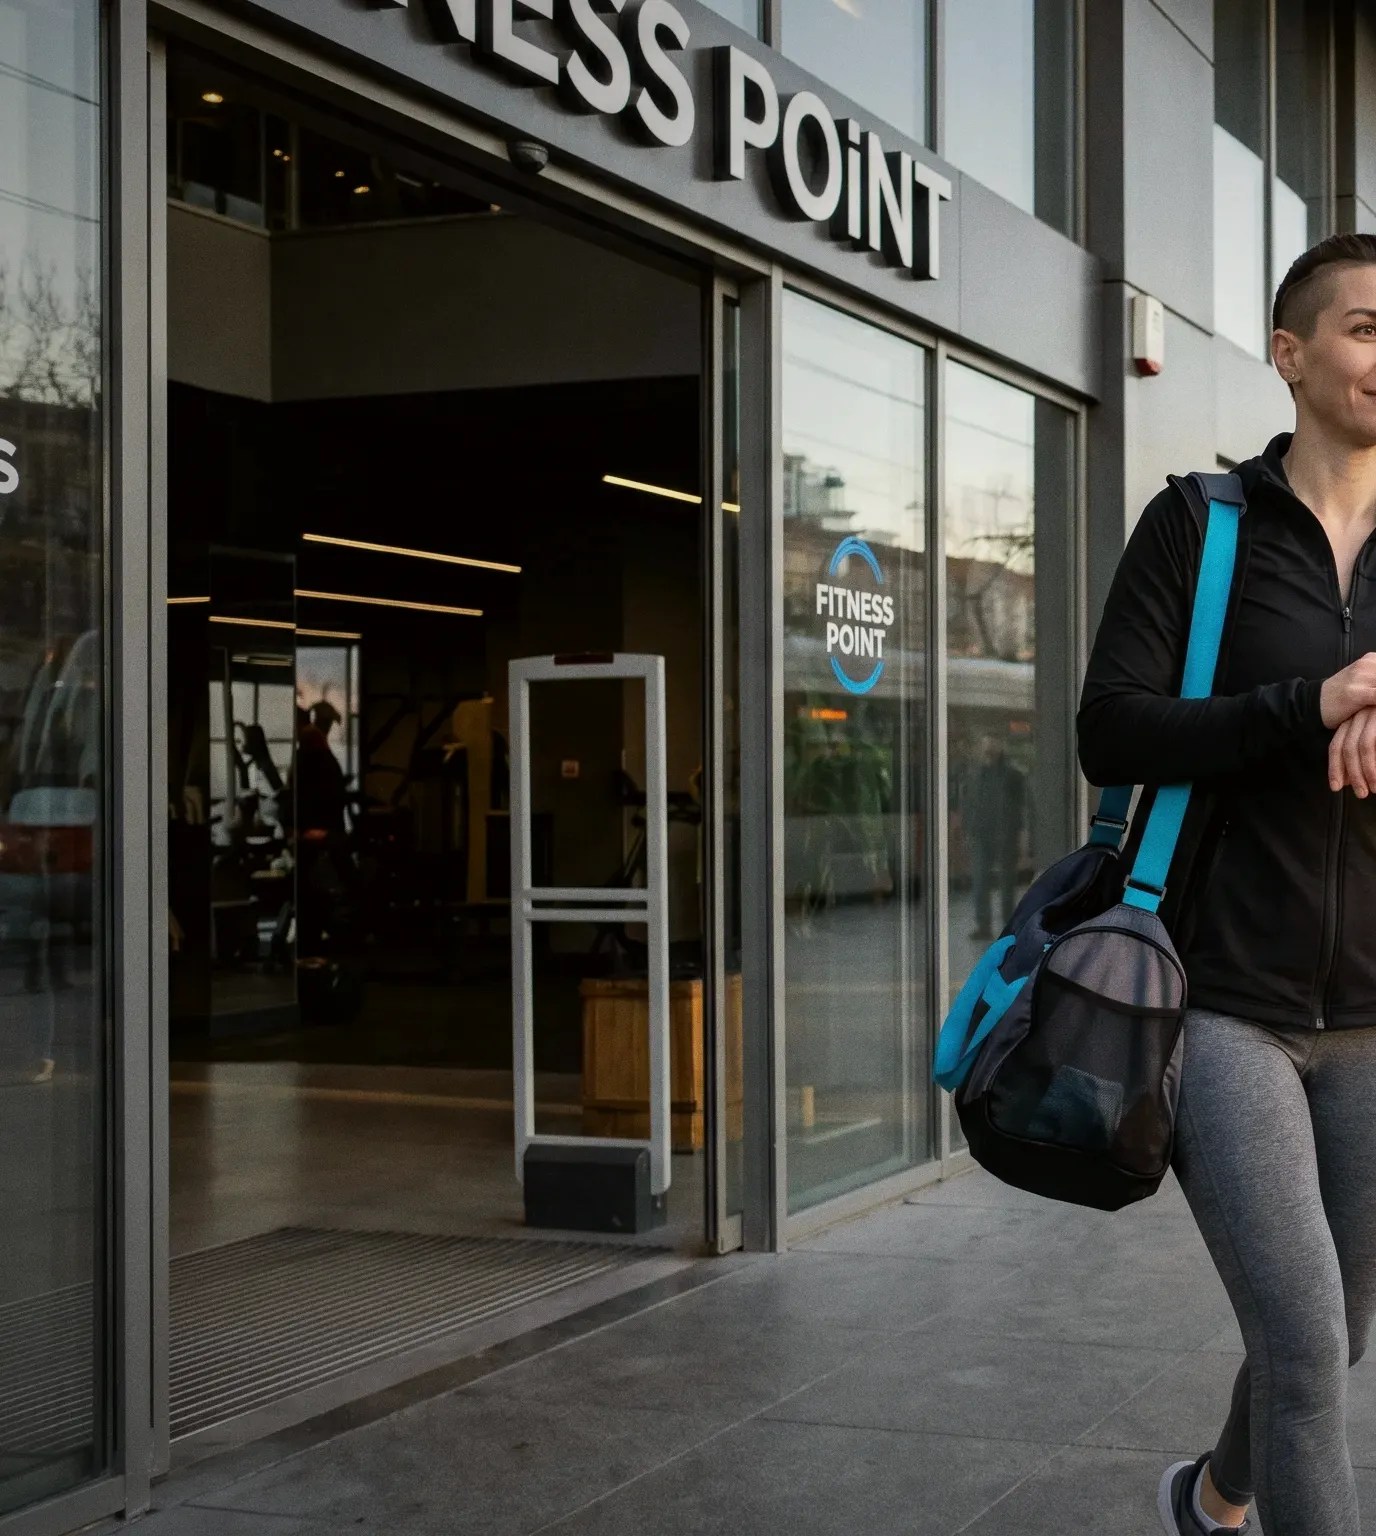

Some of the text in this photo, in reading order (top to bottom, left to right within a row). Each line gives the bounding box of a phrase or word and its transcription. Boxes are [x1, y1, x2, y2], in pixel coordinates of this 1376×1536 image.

[395, 0, 695, 147] SS
[816, 583, 895, 626] FITNESS
[826, 621, 886, 658] POINT
